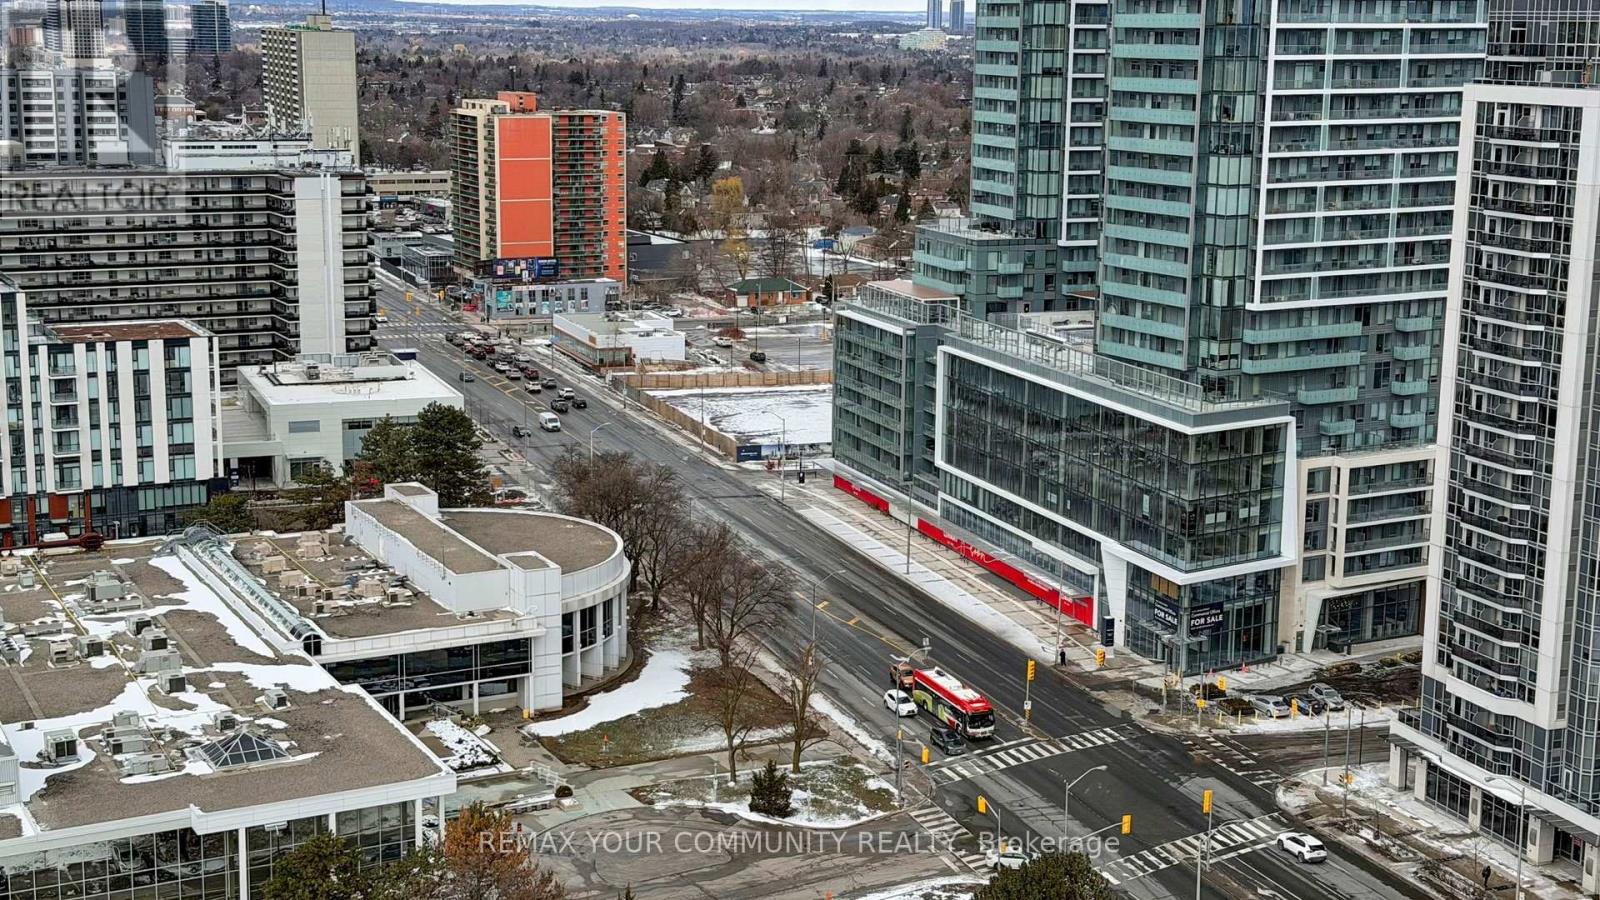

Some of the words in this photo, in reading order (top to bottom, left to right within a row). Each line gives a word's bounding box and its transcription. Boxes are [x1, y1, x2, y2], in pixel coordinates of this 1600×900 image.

[1154, 608, 1165, 618] FOR
[1165, 614, 1178, 625] SALE
[1190, 617, 1205, 627] FOR
[1206, 614, 1224, 624] SALE
